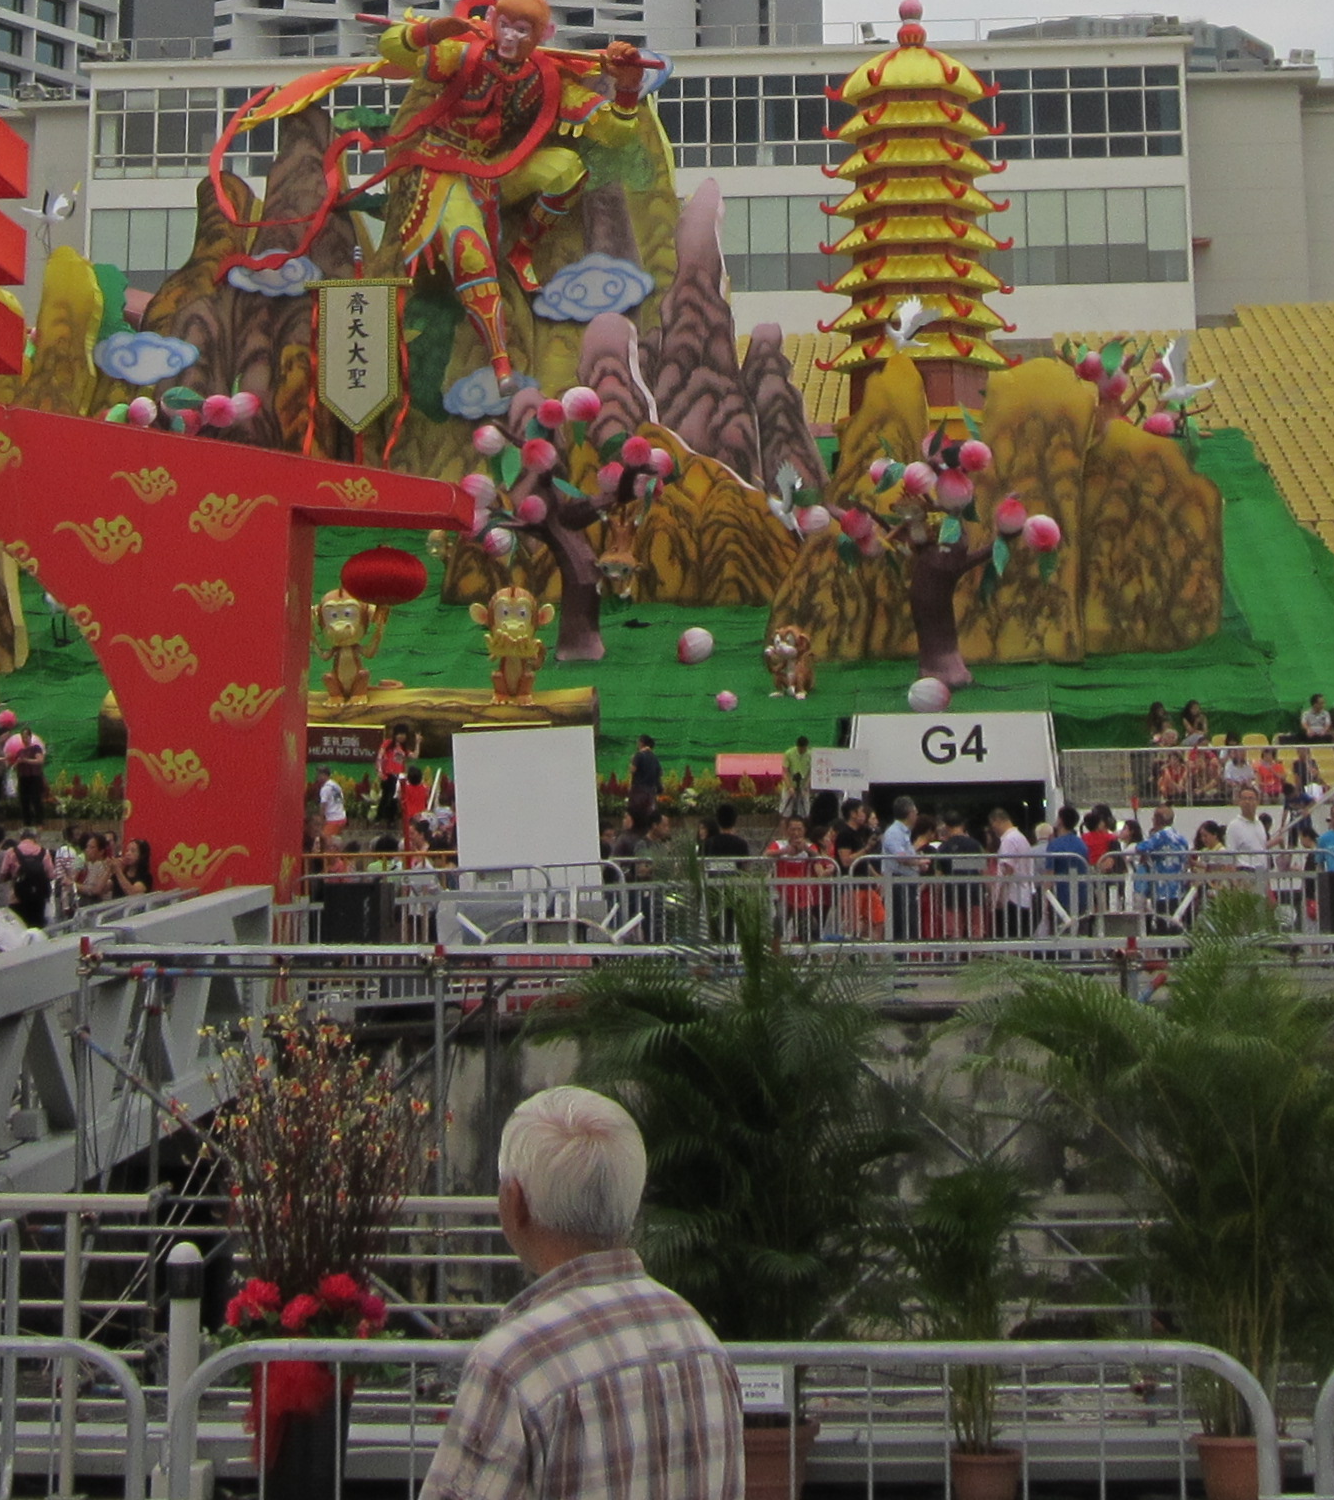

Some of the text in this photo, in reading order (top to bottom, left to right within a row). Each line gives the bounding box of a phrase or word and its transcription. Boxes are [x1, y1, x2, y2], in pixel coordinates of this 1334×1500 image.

[345, 291, 371, 390] 齊天大聖
[308, 746, 334, 756] HEAR
[336, 747, 350, 756] NO
[921, 723, 988, 765] G4
